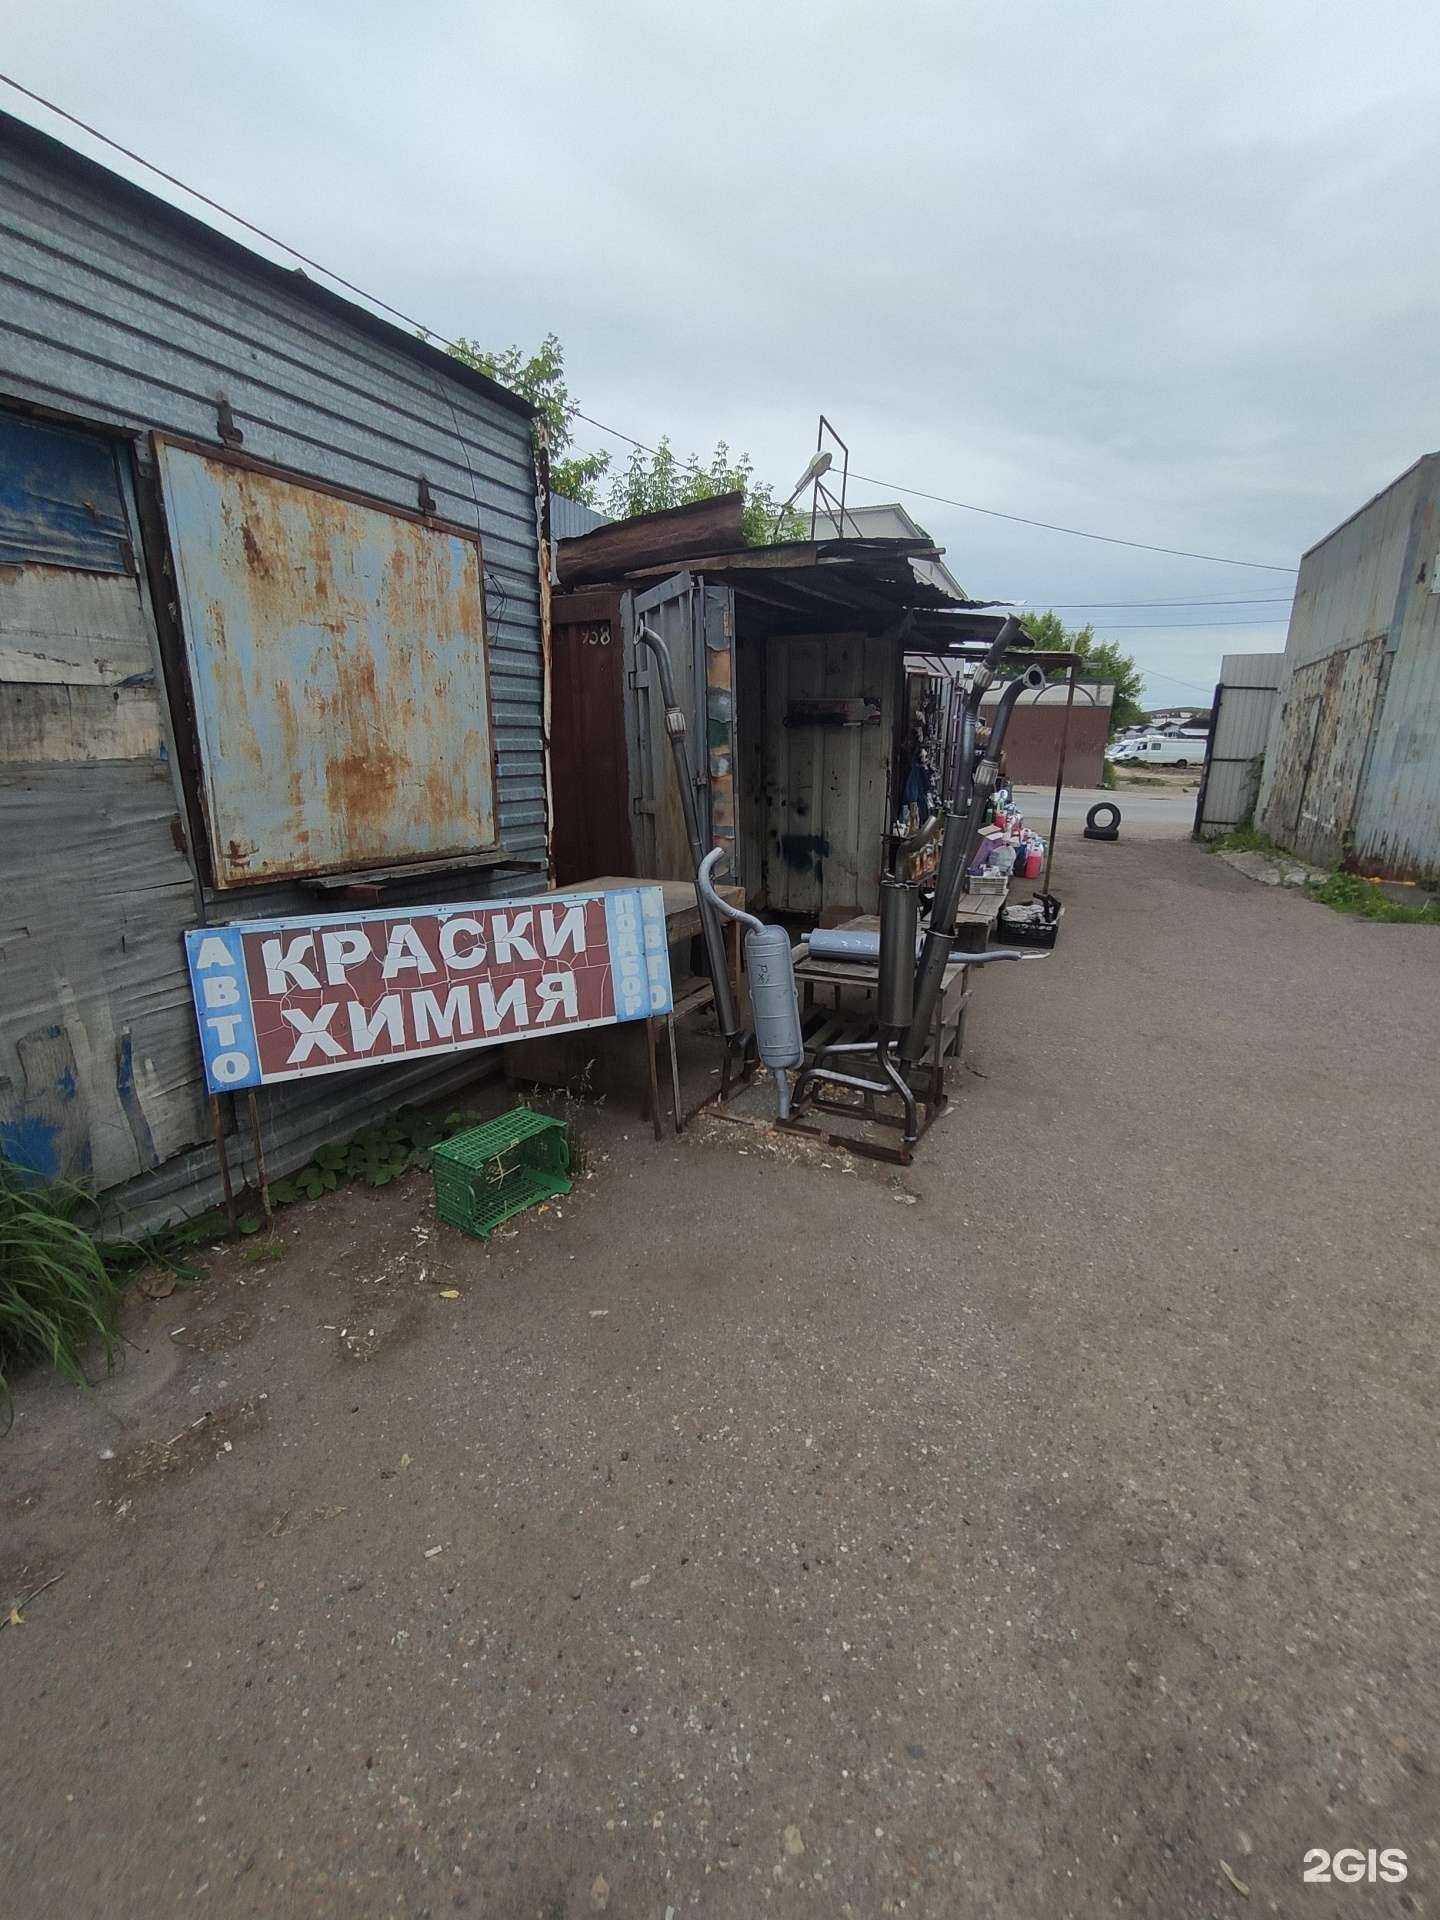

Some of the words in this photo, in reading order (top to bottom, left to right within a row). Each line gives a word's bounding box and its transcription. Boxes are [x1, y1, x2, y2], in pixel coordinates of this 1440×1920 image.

[261, 903, 588, 995] КРАСКИ
[196, 937, 250, 1083] АВТО
[281, 971, 578, 1064] ХИМИЯ
